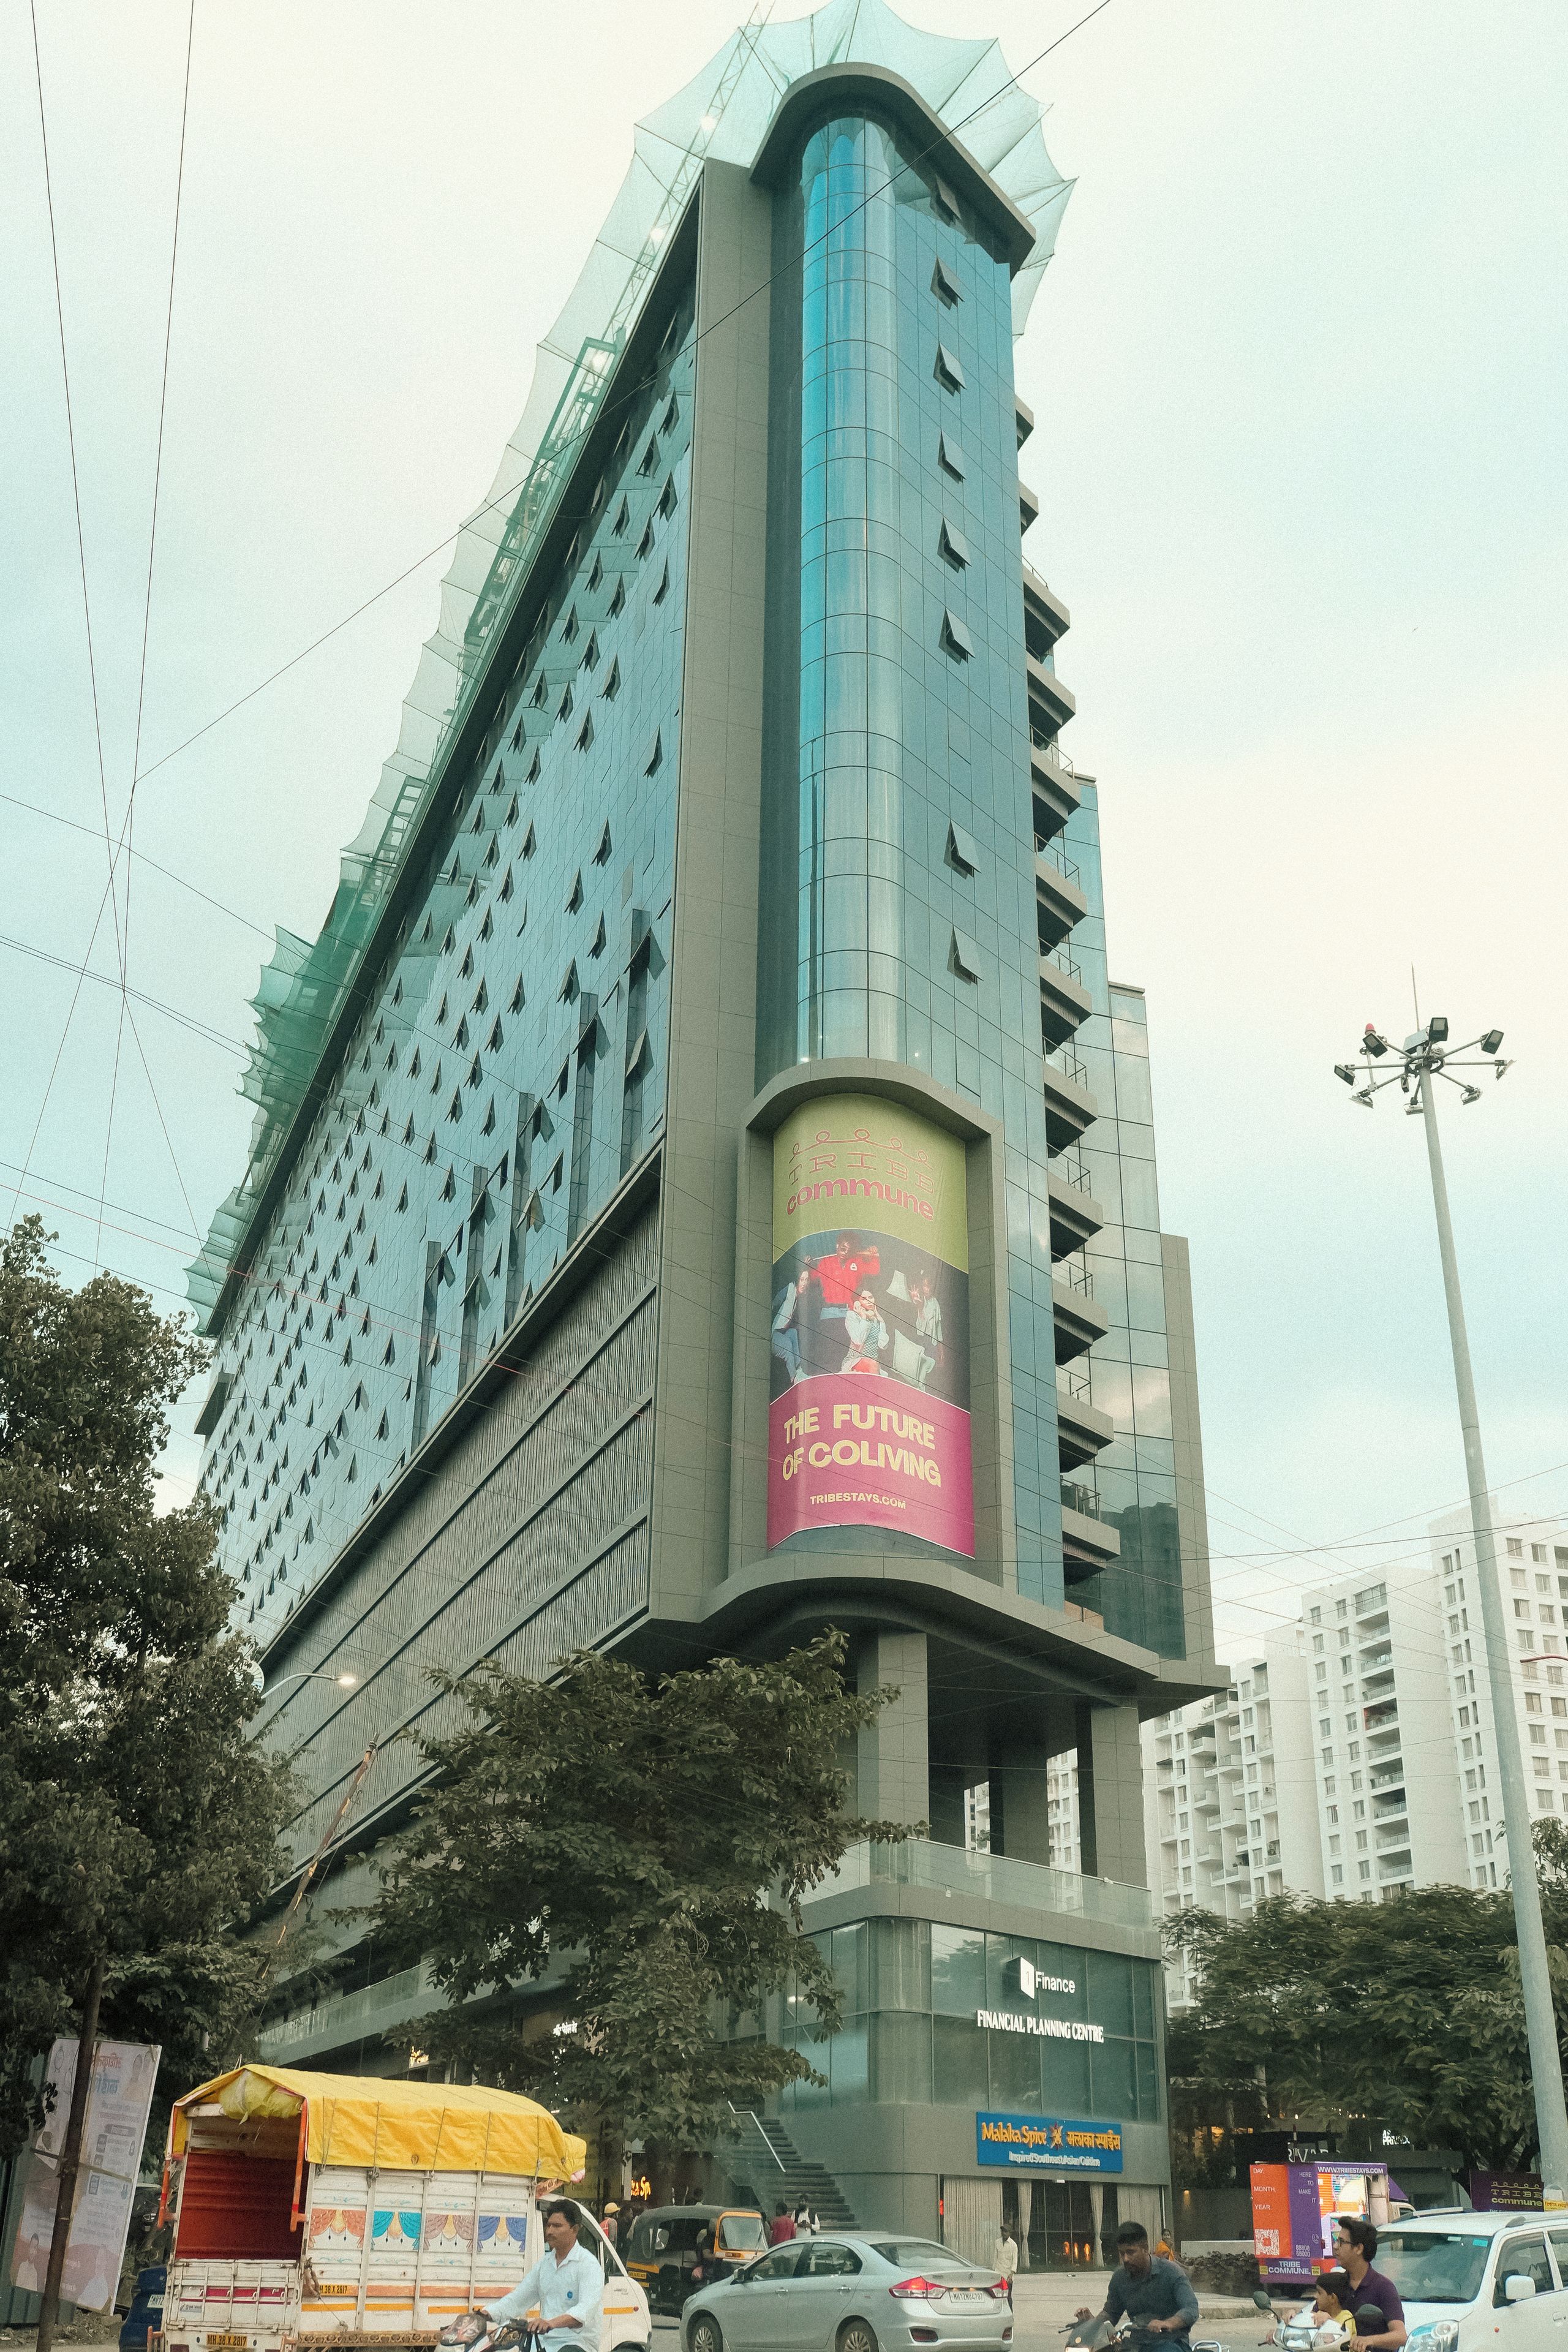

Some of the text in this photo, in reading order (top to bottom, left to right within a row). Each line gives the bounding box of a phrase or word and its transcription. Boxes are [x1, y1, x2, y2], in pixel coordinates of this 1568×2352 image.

[788, 1151, 934, 1194] TRIBE
[786, 1178, 934, 1221] commune
[783, 1404, 936, 1450] THE FUTURE
[782, 1439, 941, 1487] OF COLIVING
[810, 1492, 907, 1510] TRIBESTAYS.COM
[1035, 1970, 1076, 1994] Finance
[977, 2010, 1104, 2043] FINANCIAL PLANNING CENTRE
[981, 2122, 1047, 2148] Malaka Spice
[1066, 2131, 1095, 2148] मलाका
[1008, 2150, 1101, 2167] Inspired Southeast Asian Cuisine
[1490, 2189, 1542, 2198] TRIBE
[1491, 2198, 1543, 2206] commune
[325, 2285, 331, 2294] 38
[332, 2285, 336, 2294] X
[336, 2285, 348, 2294] 2817
